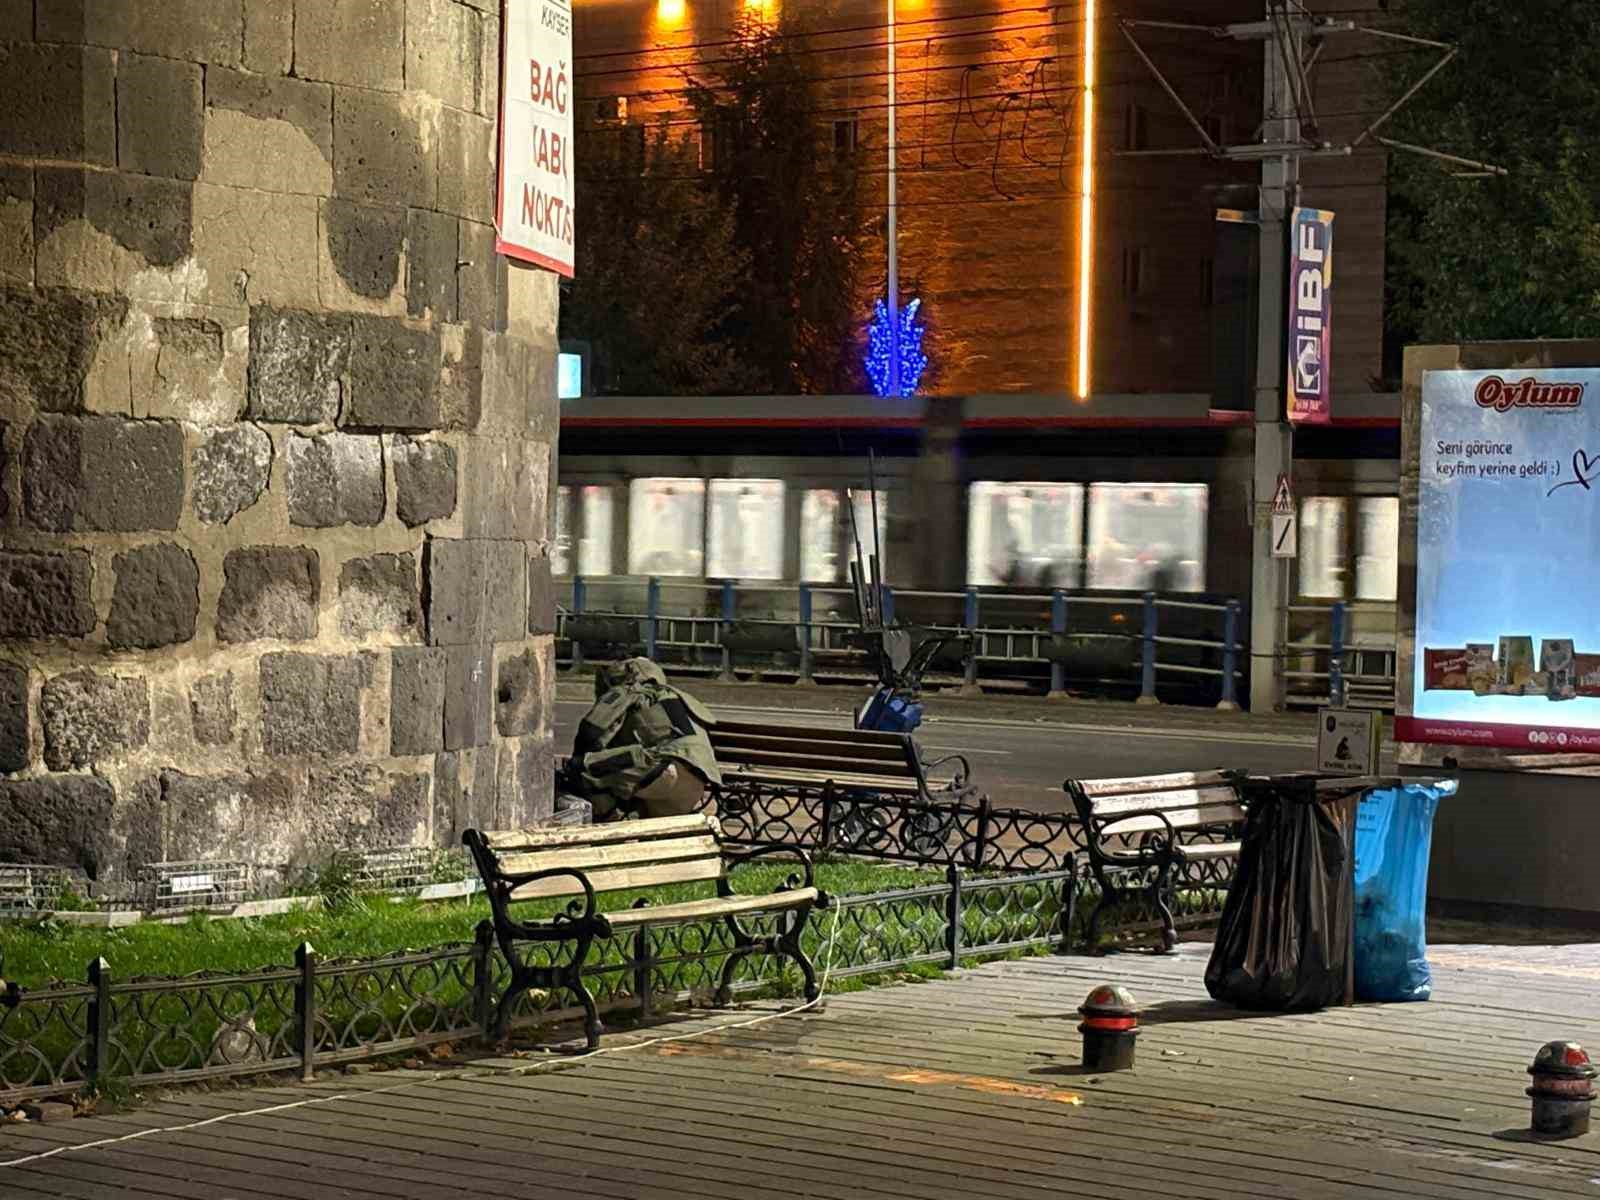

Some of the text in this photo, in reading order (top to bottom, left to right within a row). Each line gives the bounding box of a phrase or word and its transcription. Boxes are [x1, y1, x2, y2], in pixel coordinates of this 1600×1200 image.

[1475, 376, 1584, 412] Oylum
[1437, 440, 1513, 457] Seni görünce
[1436, 461, 1476, 478] keyfim
[1478, 461, 1515, 477] yerine
[1519, 461, 1548, 478] geldi
